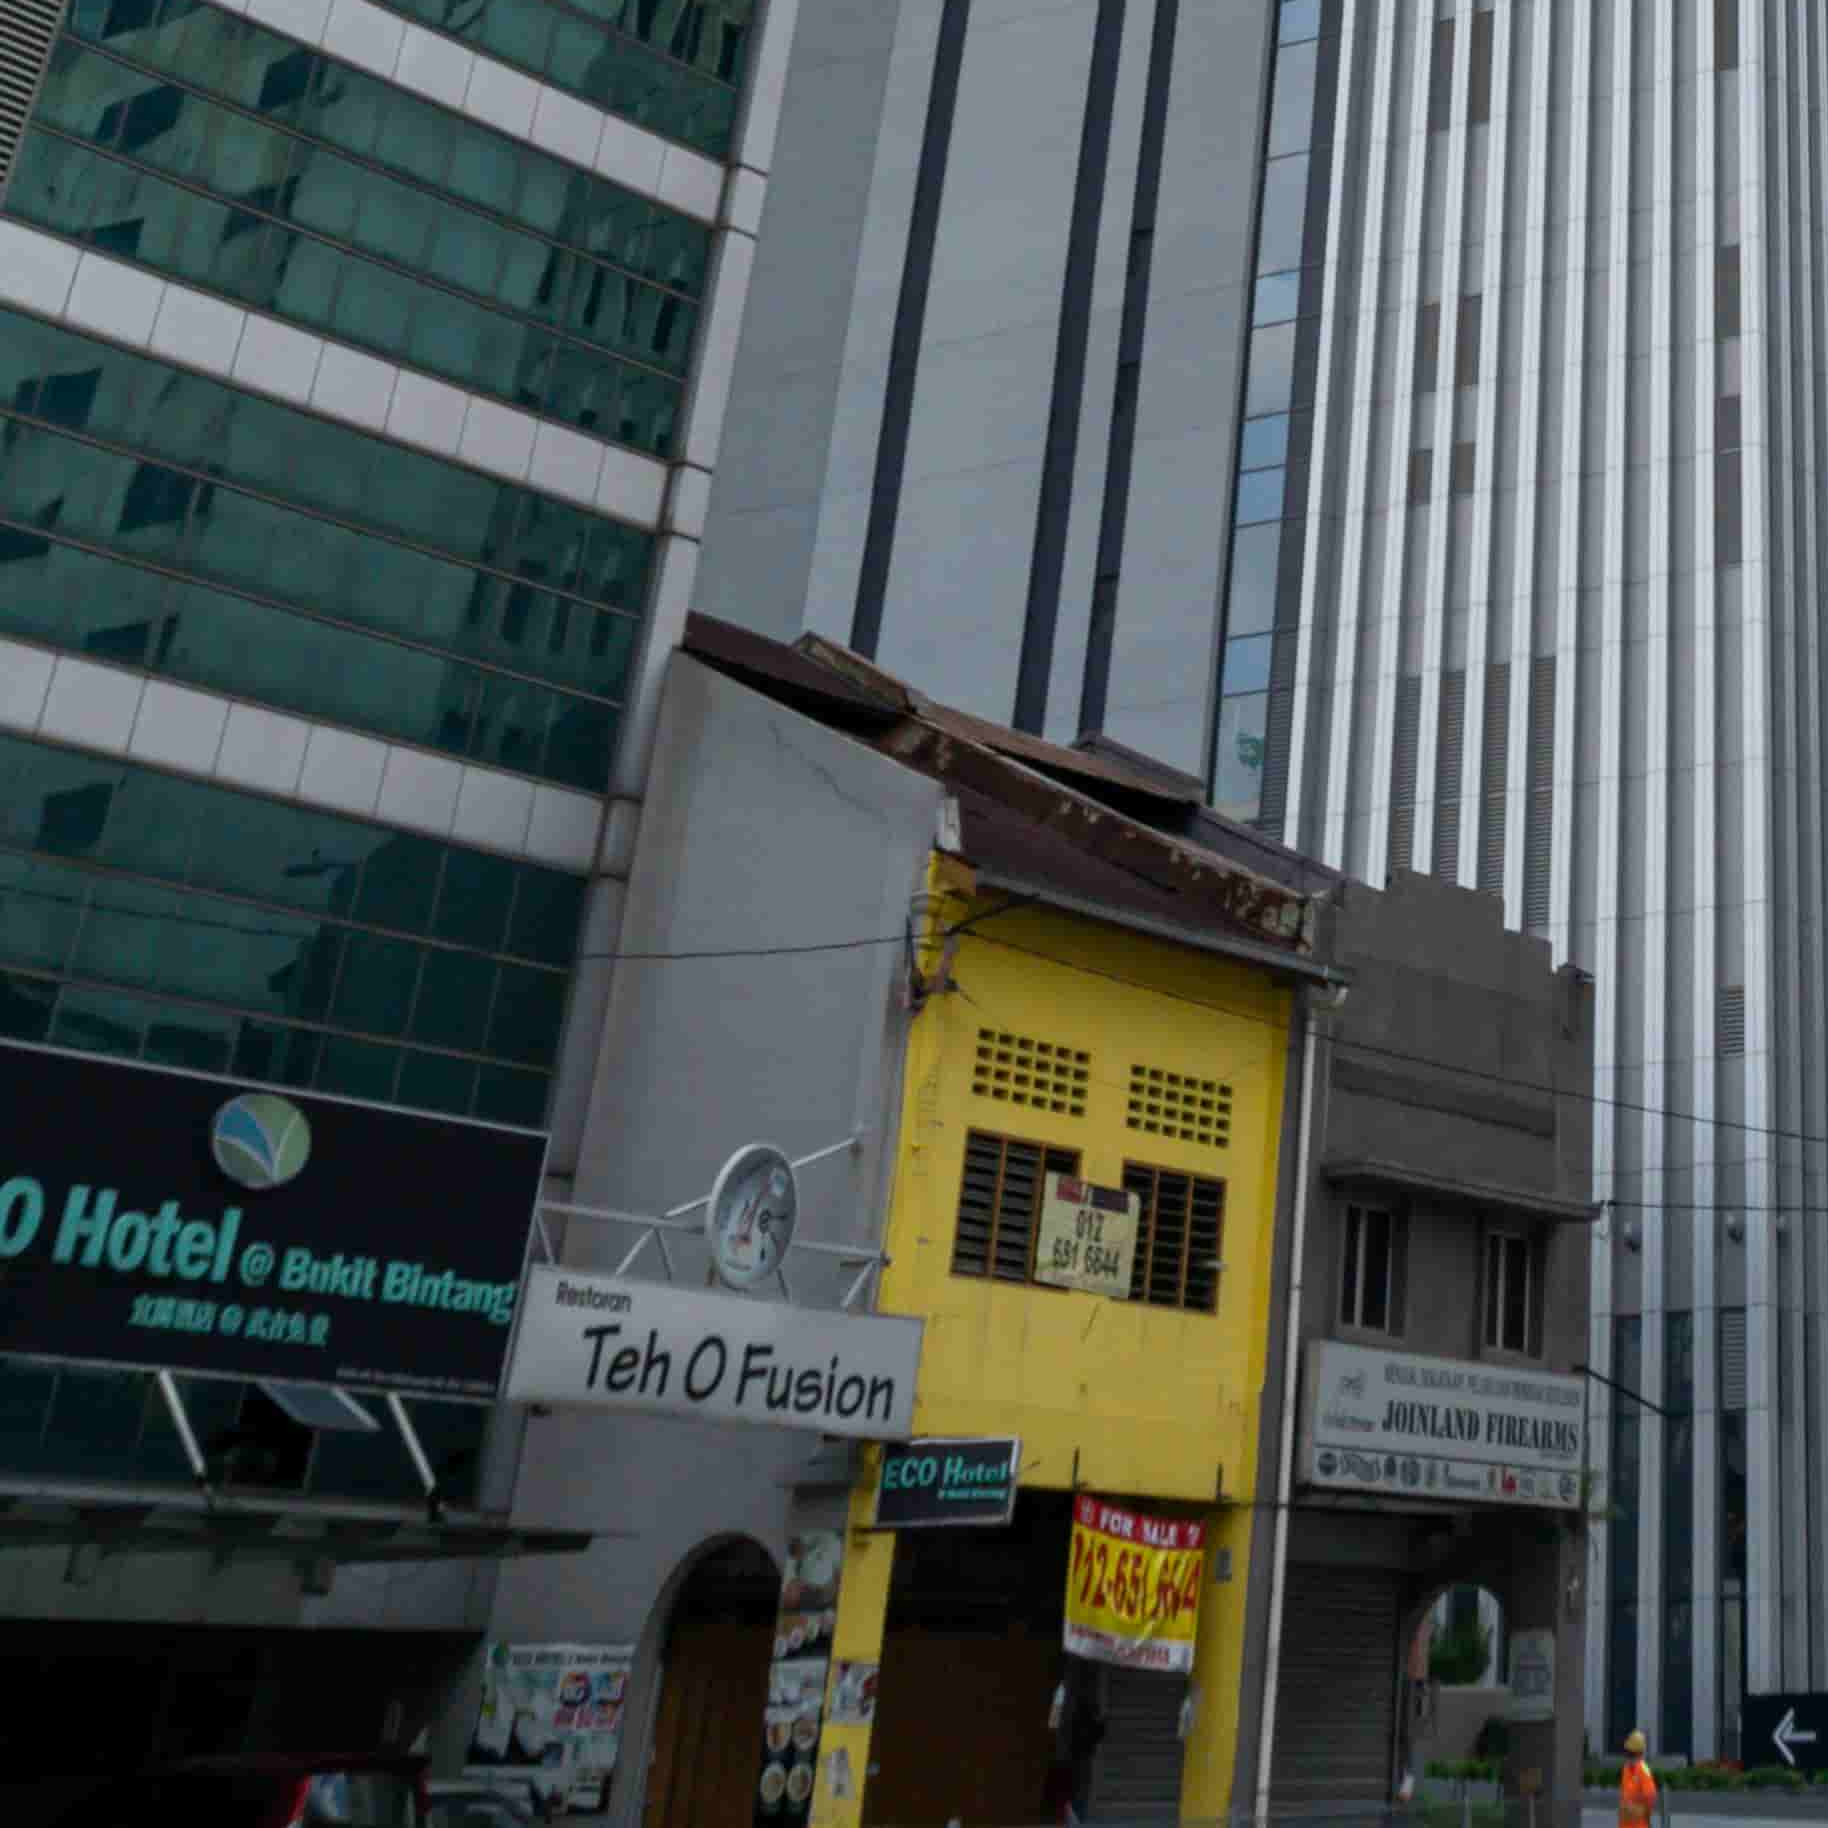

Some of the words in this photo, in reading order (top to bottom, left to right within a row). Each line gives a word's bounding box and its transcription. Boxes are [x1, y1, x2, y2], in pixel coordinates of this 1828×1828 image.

[52, 1184, 244, 1284] Hotel
[237, 1242, 278, 1287] @
[279, 1247, 378, 1299] Bukit
[381, 1260, 516, 1327] Bintang
[555, 1279, 632, 1313] Restoran
[582, 1324, 671, 1397] Teh
[683, 1335, 728, 1402] O
[735, 1343, 896, 1422] Fusion
[1381, 1399, 1480, 1442] JOINLAND
[1486, 1412, 1578, 1452] FIREARMS
[882, 1456, 938, 1490] ECO
[943, 1455, 1008, 1486] Hotel
[1099, 1507, 1134, 1537] FOR
